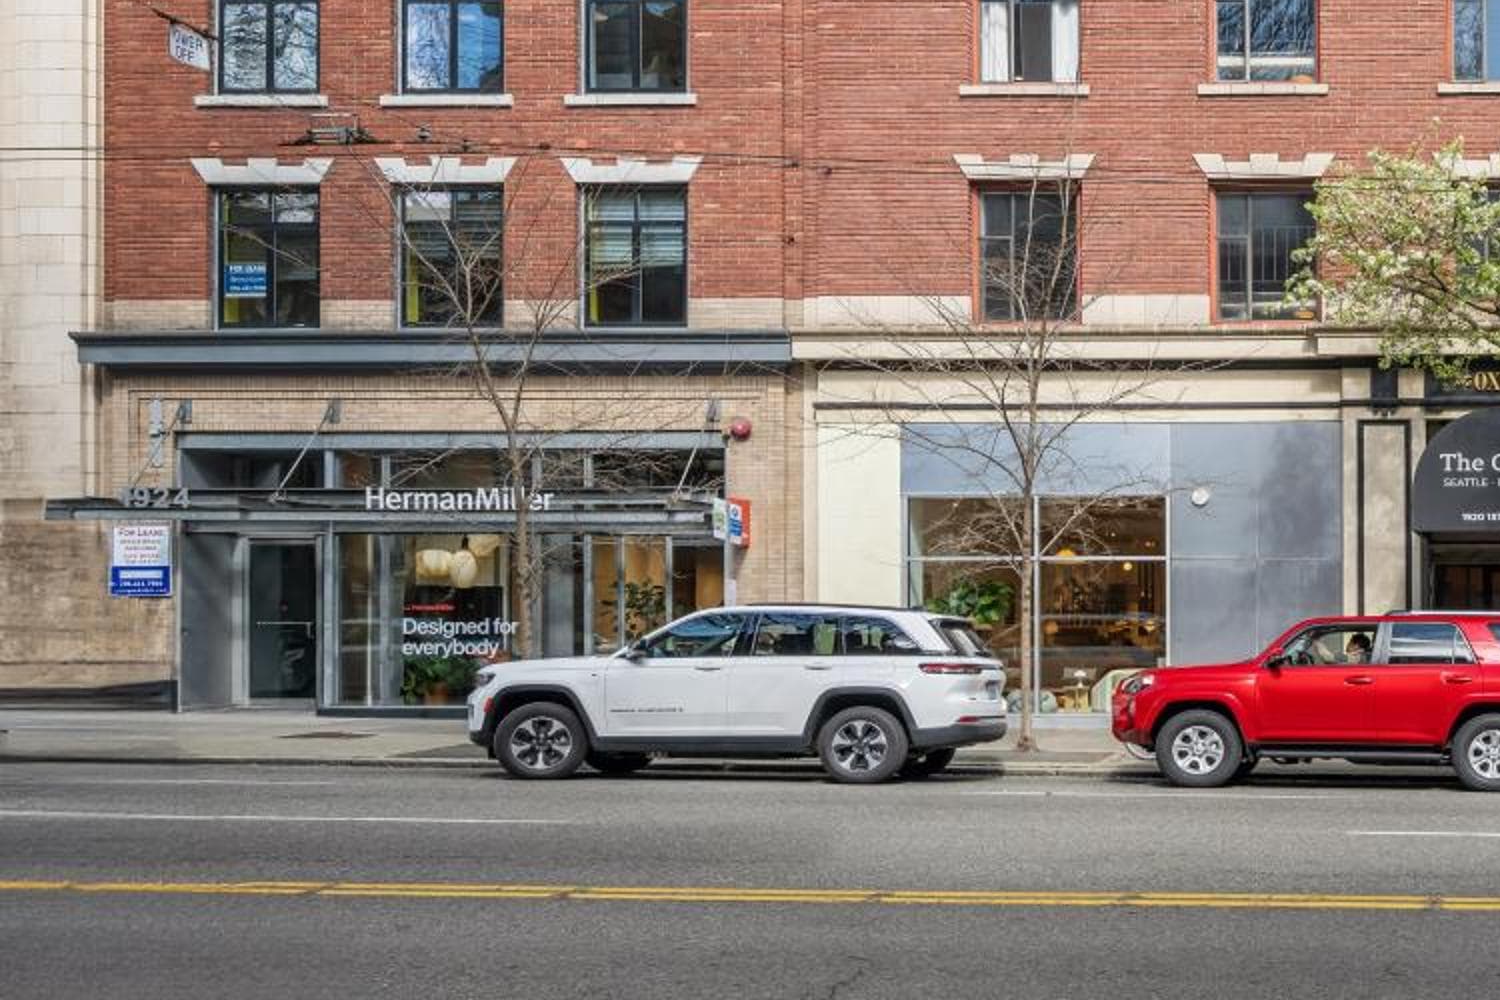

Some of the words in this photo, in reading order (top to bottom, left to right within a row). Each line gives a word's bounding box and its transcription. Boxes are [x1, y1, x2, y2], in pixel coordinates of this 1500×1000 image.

[1439, 453, 1485, 472] The
[1443, 477, 1488, 487] SEATTLE
[402, 617, 489, 638] Designed
[493, 617, 520, 635] for
[402, 639, 499, 659] everybody
